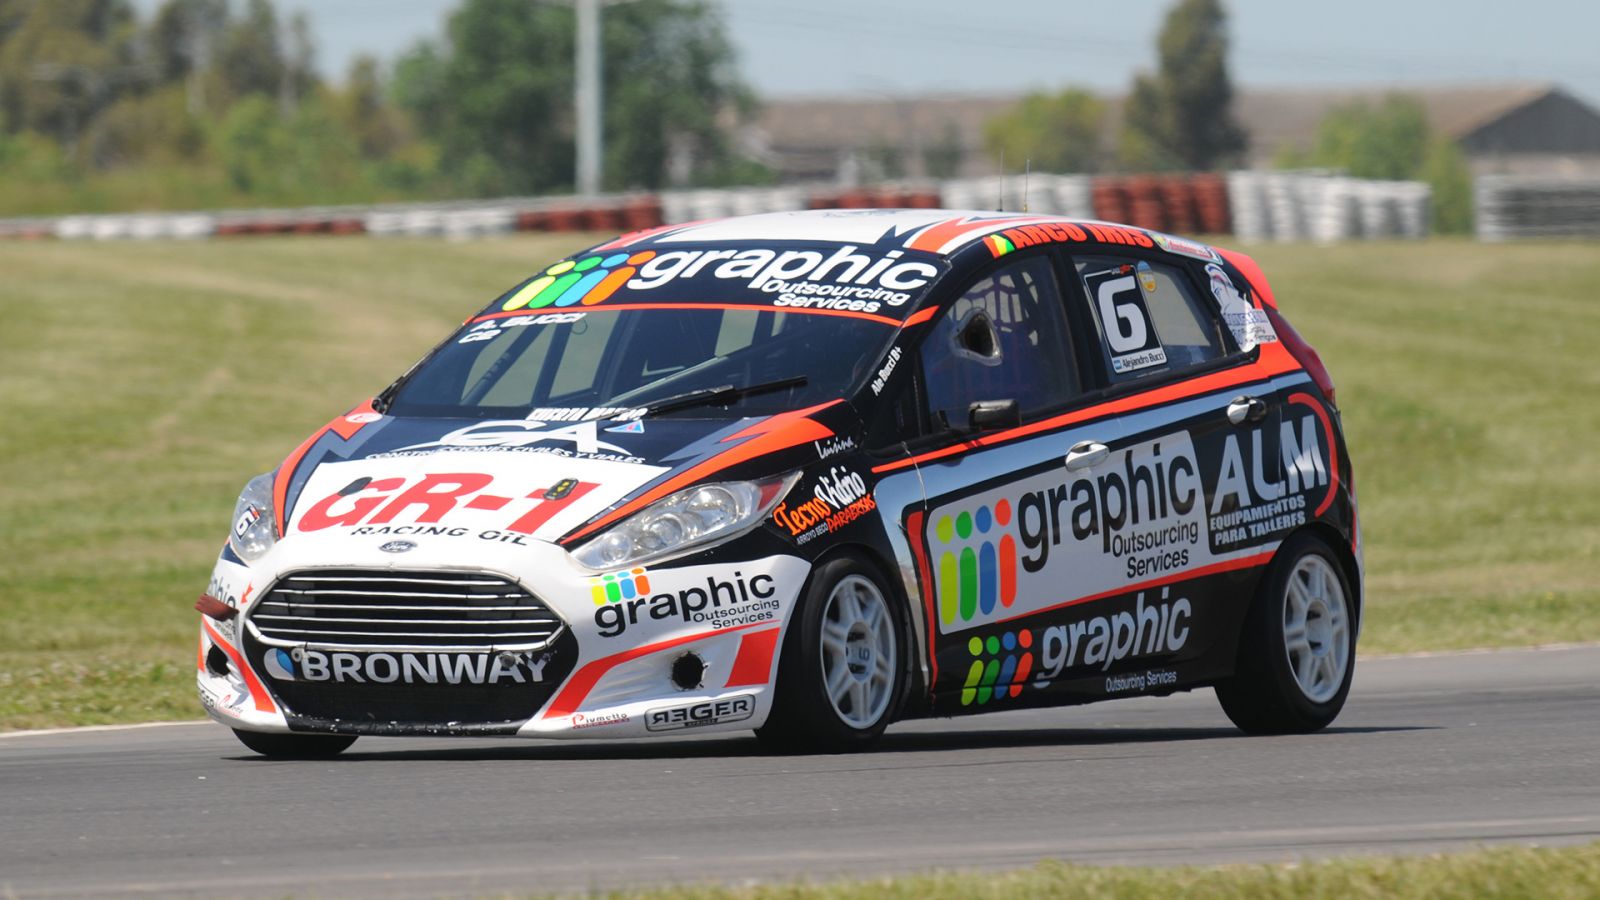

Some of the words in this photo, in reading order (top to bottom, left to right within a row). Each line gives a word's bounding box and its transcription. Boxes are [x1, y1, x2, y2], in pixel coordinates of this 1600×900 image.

[1002, 222, 1088, 250] ARCO
[1081, 224, 1154, 248] IRIS
[627, 246, 938, 290] graphic
[762, 279, 910, 306] Outsourcing
[773, 292, 881, 313] Services
[500, 312, 587, 327] BUCCI
[1098, 275, 1148, 353] 6
[871, 378, 885, 396] Ale
[878, 355, 897, 382] Bucci
[1122, 354, 1149, 369] Alejandro
[1149, 352, 1164, 363] Bucci
[511, 446, 573, 458] CIVILES
[576, 451, 585, 459] Y
[586, 453, 645, 464] VIALES
[1210, 414, 1327, 516] ALM
[297, 473, 602, 535] GR-1
[826, 494, 875, 533] PARABRISAS
[1018, 443, 1196, 573] graphic
[1210, 494, 1305, 531] EQUIPAMIENTOS
[236, 510, 255, 535] 6
[350, 526, 469, 537] RACING
[797, 528, 816, 545] ARROYO
[816, 522, 828, 535] SECO
[1215, 527, 1247, 546] PARA
[1249, 511, 1305, 538] TALLERES
[1112, 521, 1198, 558] Outsourcing
[1127, 549, 1188, 578] Services
[594, 571, 775, 638] graphic
[693, 599, 780, 623] Outsourcing
[712, 611, 773, 629] Services
[1033, 586, 1191, 688] graphic
[302, 651, 548, 684] BRONWAY
[1106, 674, 1145, 692] Outsourcing
[1147, 671, 1176, 685] Services
